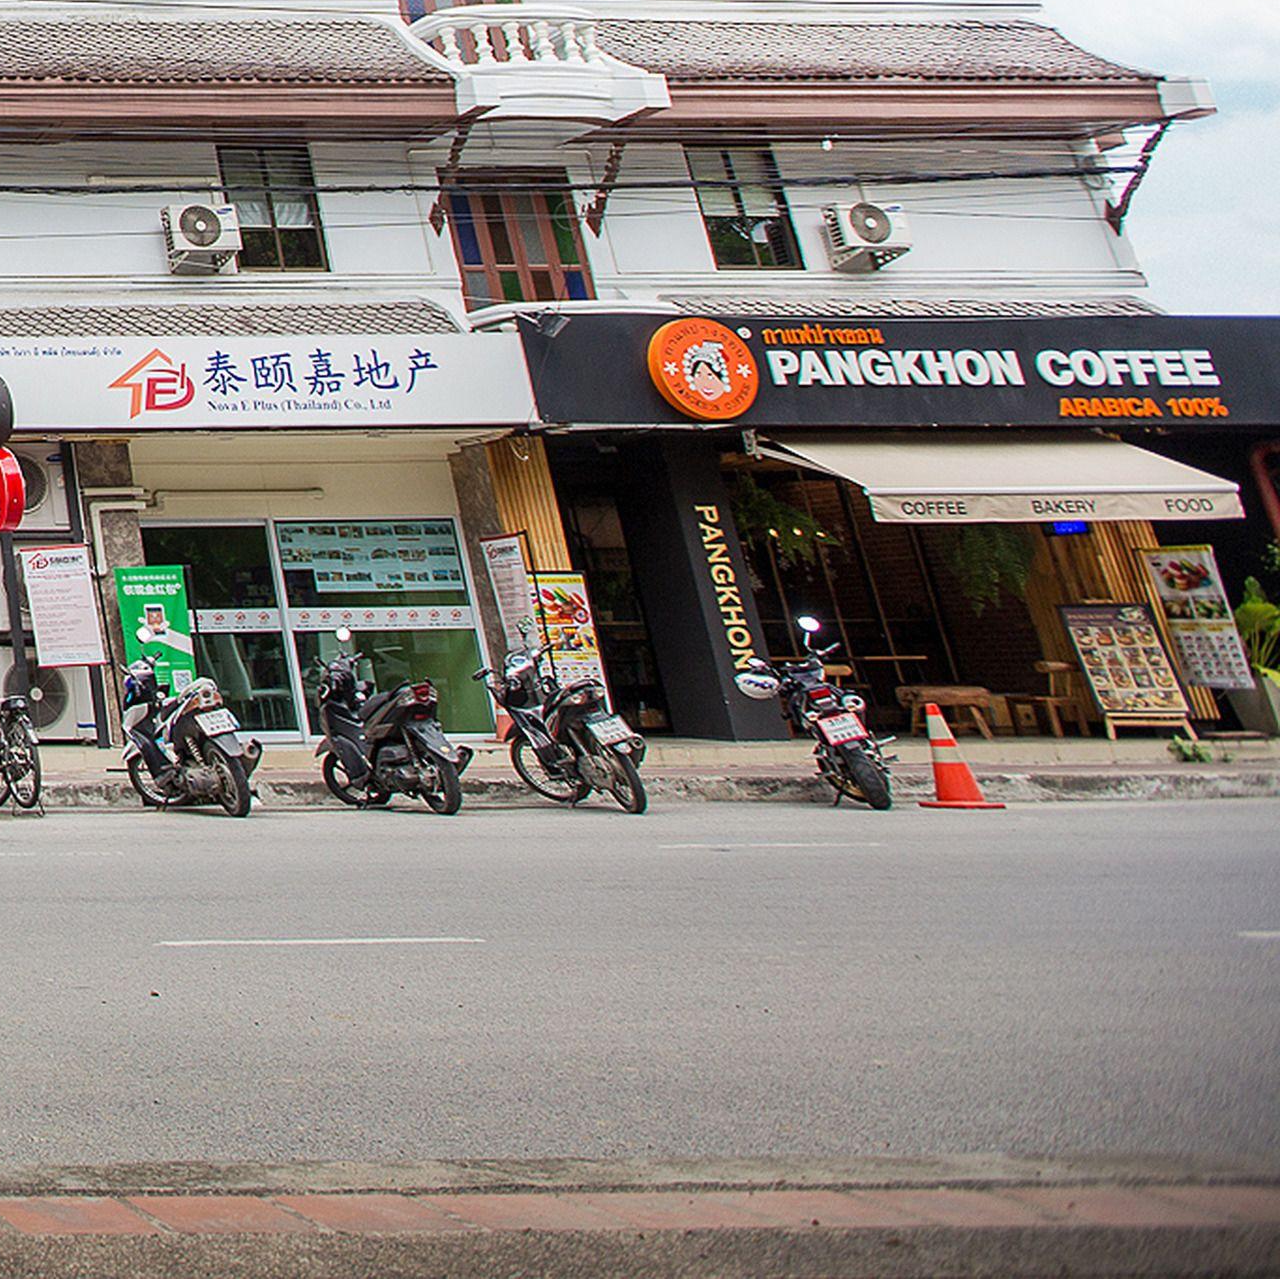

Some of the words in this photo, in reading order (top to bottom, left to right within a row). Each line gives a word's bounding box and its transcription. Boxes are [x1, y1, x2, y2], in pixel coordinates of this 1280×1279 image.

[203, 348, 439, 397] 泰颐嘉地产
[765, 348, 1026, 387] PANGKHON
[1036, 348, 1222, 387] COFFEE
[208, 400, 238, 412] Nova
[253, 400, 278, 412] Plus
[280, 400, 341, 413] (Thailand)
[1059, 397, 1164, 417] ARABICA
[1166, 397, 1230, 417] 100%
[900, 499, 967, 516] COFFEE
[1031, 499, 1098, 515] BAKERY
[1165, 498, 1214, 513] FOOD
[694, 504, 757, 671] PANGKHON
